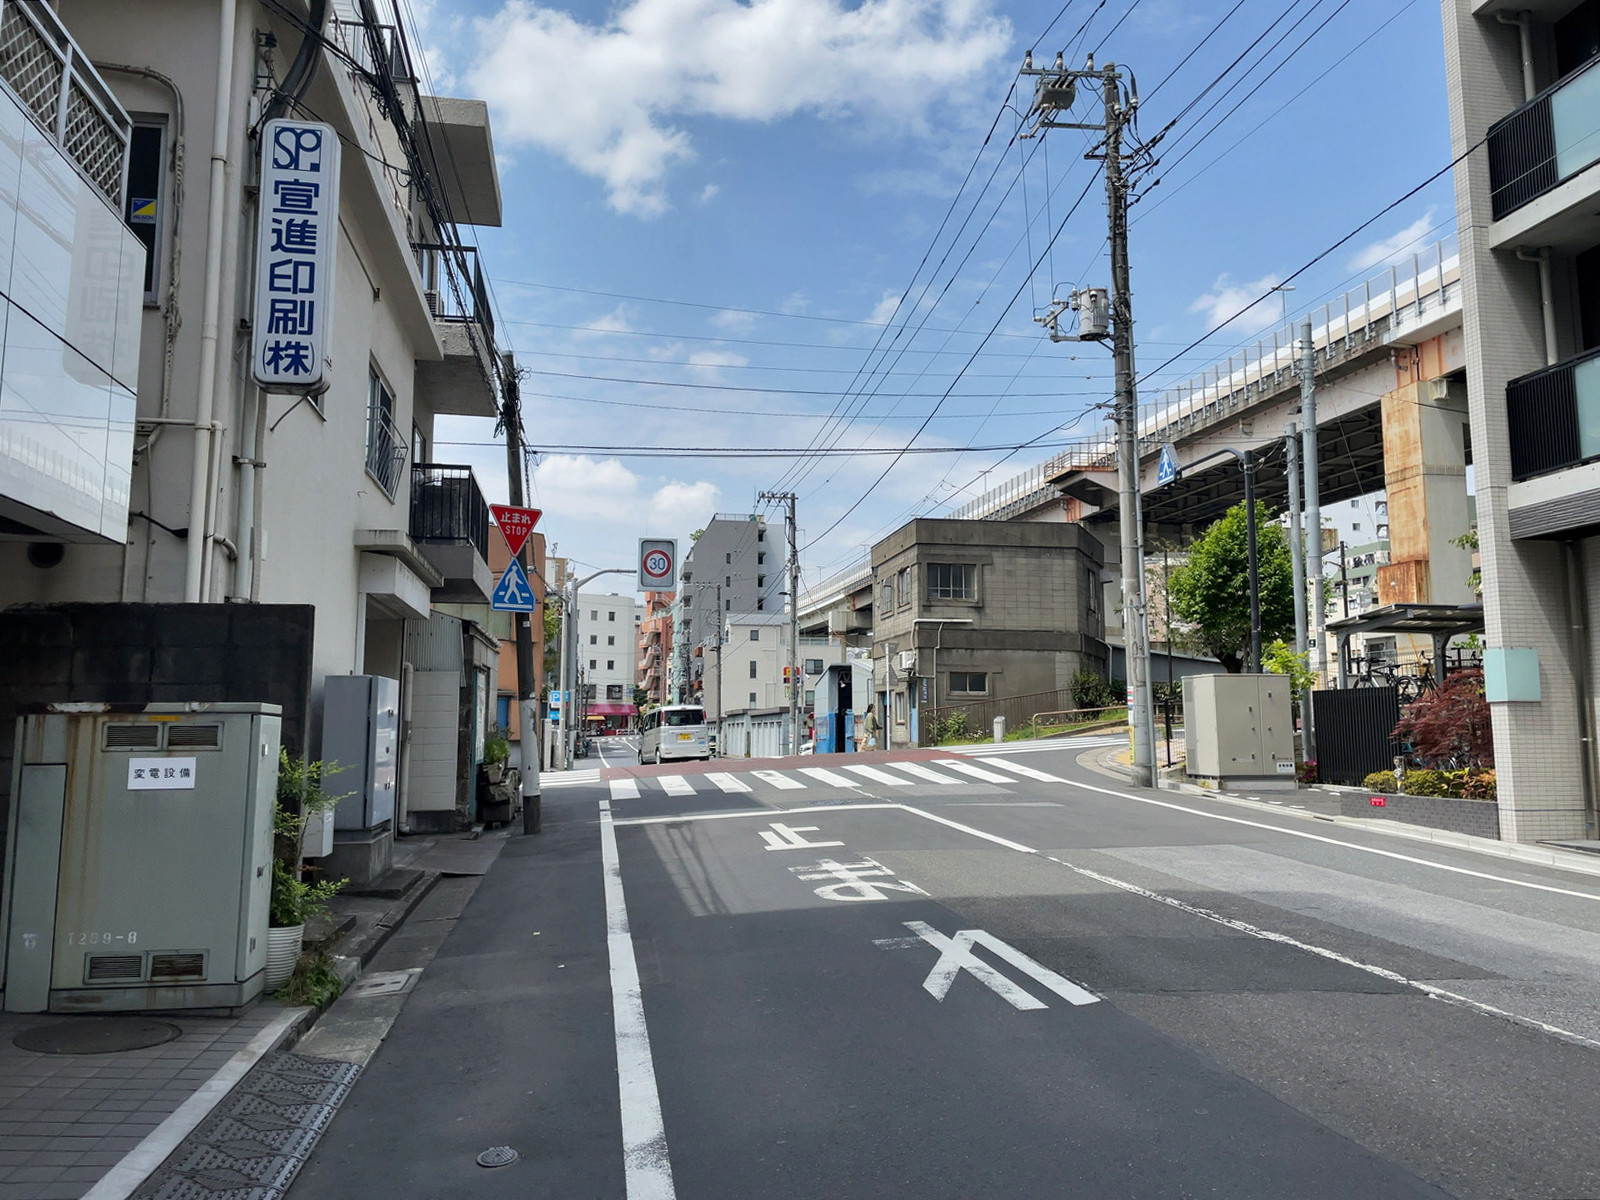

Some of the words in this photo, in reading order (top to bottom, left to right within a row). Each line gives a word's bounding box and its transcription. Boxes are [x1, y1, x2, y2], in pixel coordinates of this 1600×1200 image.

[500, 511, 532, 525] 止まれ
[505, 525, 528, 536] STOP
[649, 557, 666, 571] 30
[133, 767, 191, 779] 変電設備
